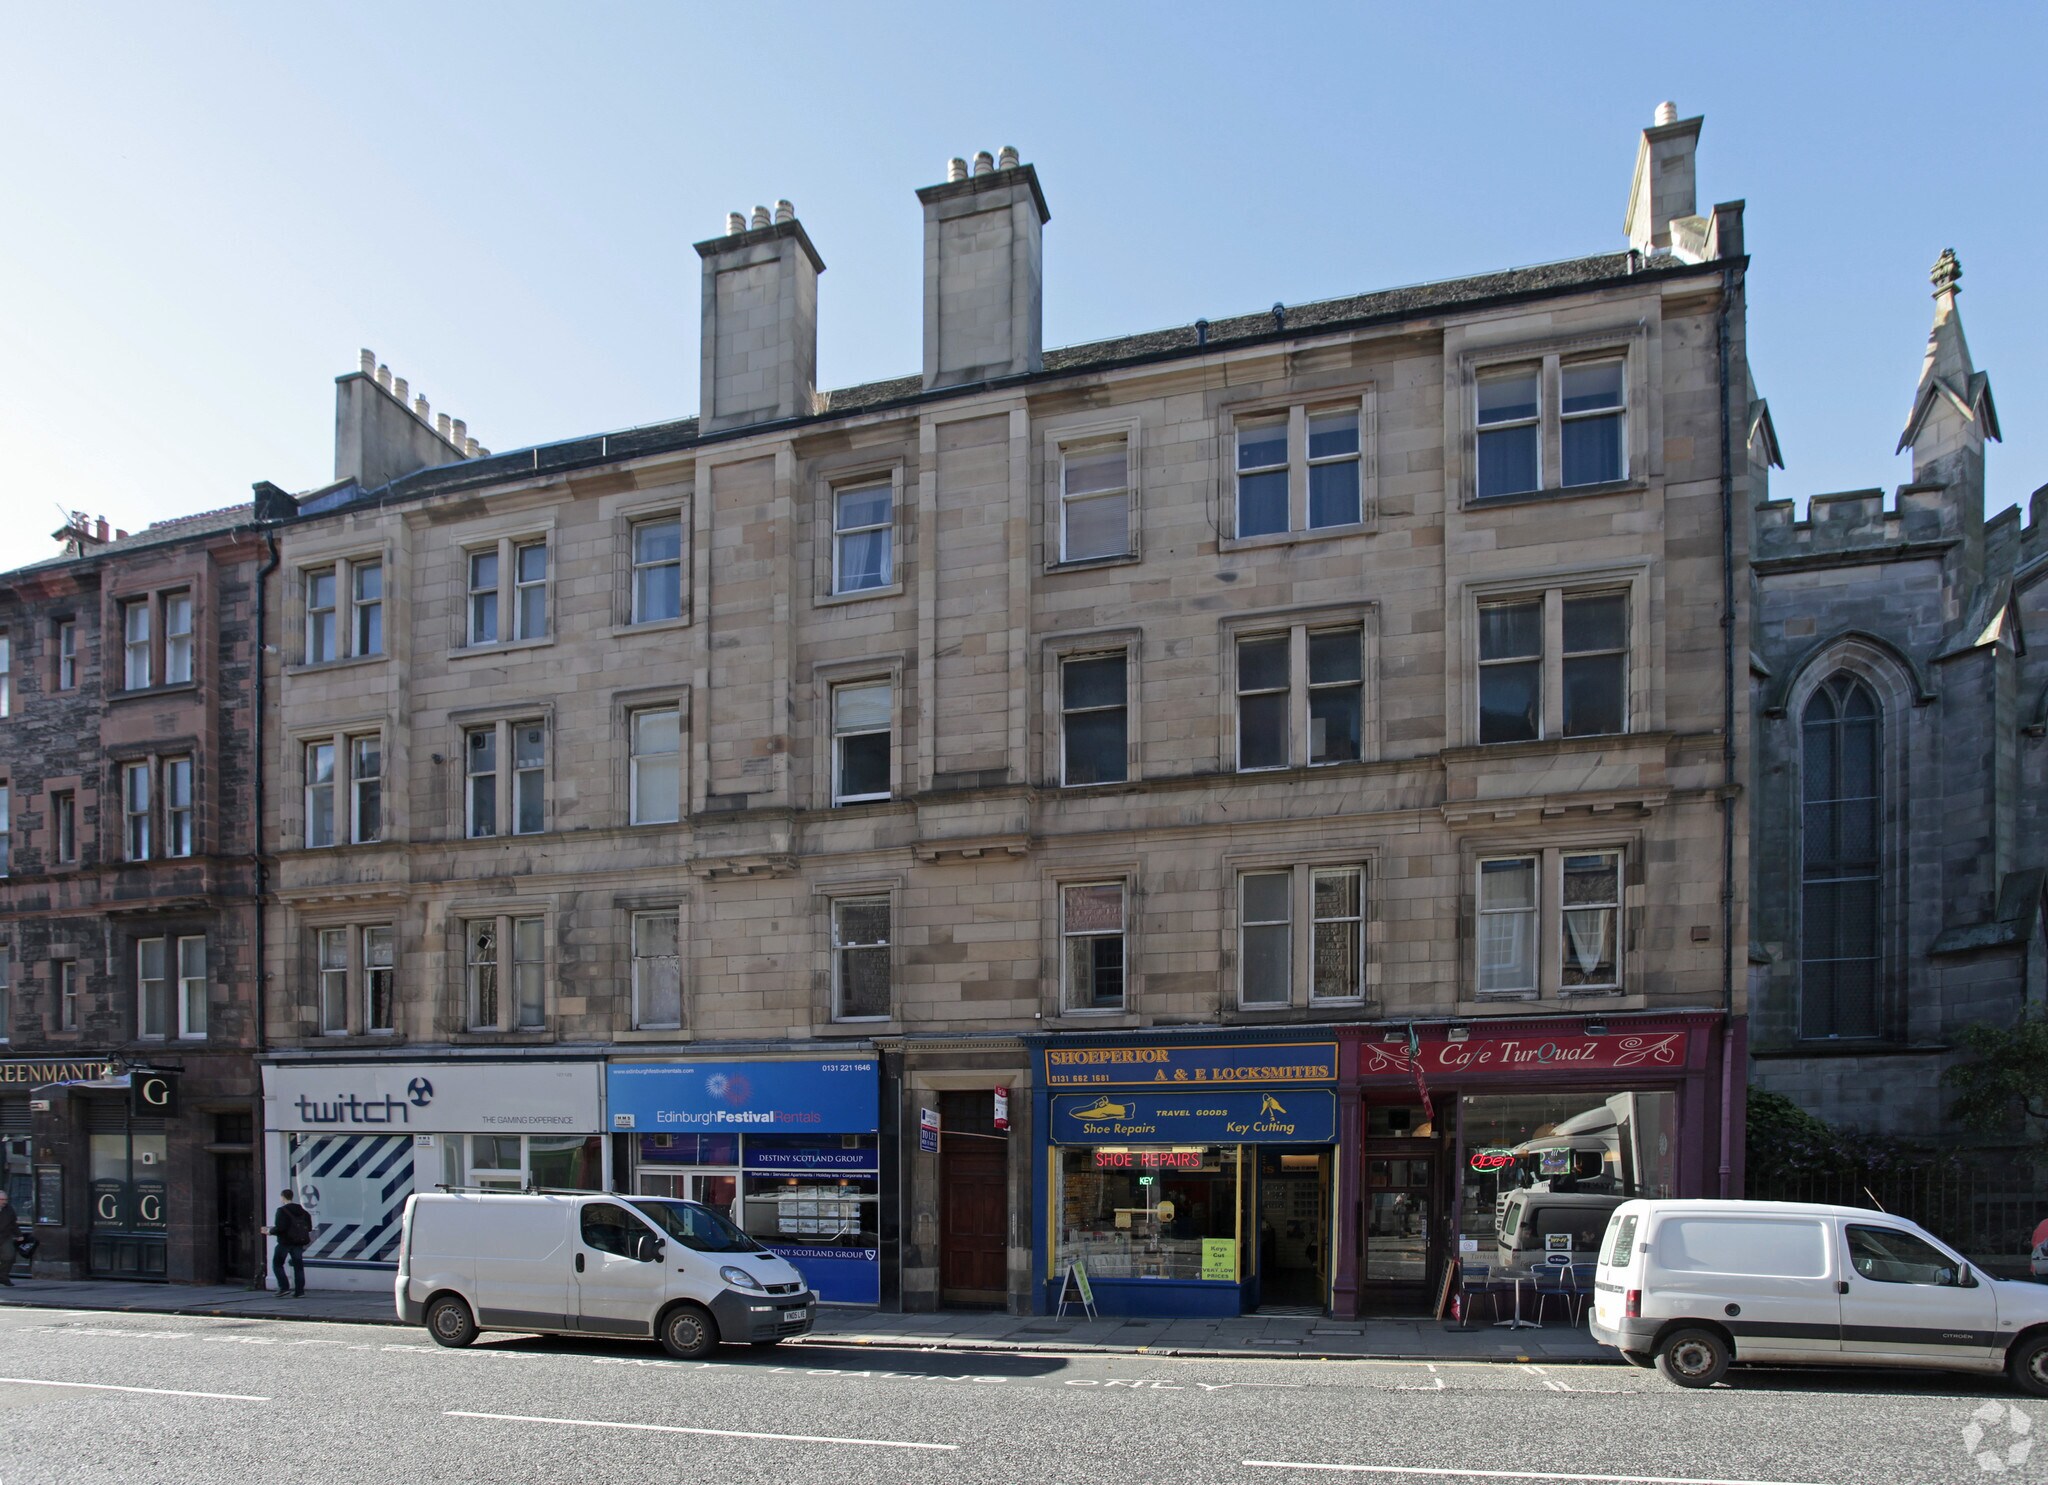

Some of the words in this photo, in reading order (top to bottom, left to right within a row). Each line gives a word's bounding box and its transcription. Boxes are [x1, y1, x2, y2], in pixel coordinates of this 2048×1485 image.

[1050, 1049, 1170, 1065] SHOEPERIOR
[1439, 1040, 1493, 1072] Cafe
[1154, 1068, 1168, 1081] A
[1173, 1068, 1188, 1081] &
[1195, 1068, 1206, 1080] E
[1212, 1065, 1329, 1080] LOCKSMITHS
[143, 1078, 170, 1105] G
[295, 1094, 408, 1123] twitch
[482, 1116, 496, 1124] THE
[497, 1116, 527, 1124] GAMING
[529, 1116, 573, 1125] EXPERIENCE
[1226, 1122, 1249, 1135] Key
[1253, 1121, 1295, 1135] Cutting
[1083, 1123, 1110, 1134] Shoe
[1114, 1123, 1156, 1136] Repairs
[759, 1154, 791, 1162] DESTINY
[835, 1155, 863, 1163] GROUP
[1096, 1152, 1133, 1167] SHOE
[1141, 1152, 1200, 1167] REPAIRS
[1470, 1153, 1516, 1168] Open
[1139, 1177, 1153, 1185] KEY
[98, 1194, 118, 1219] G
[141, 1195, 161, 1220] G
[792, 1249, 834, 1258] SCOTLAND
[835, 1250, 863, 1259] GROUP
[1064, 1378, 1234, 1391] ONLY
